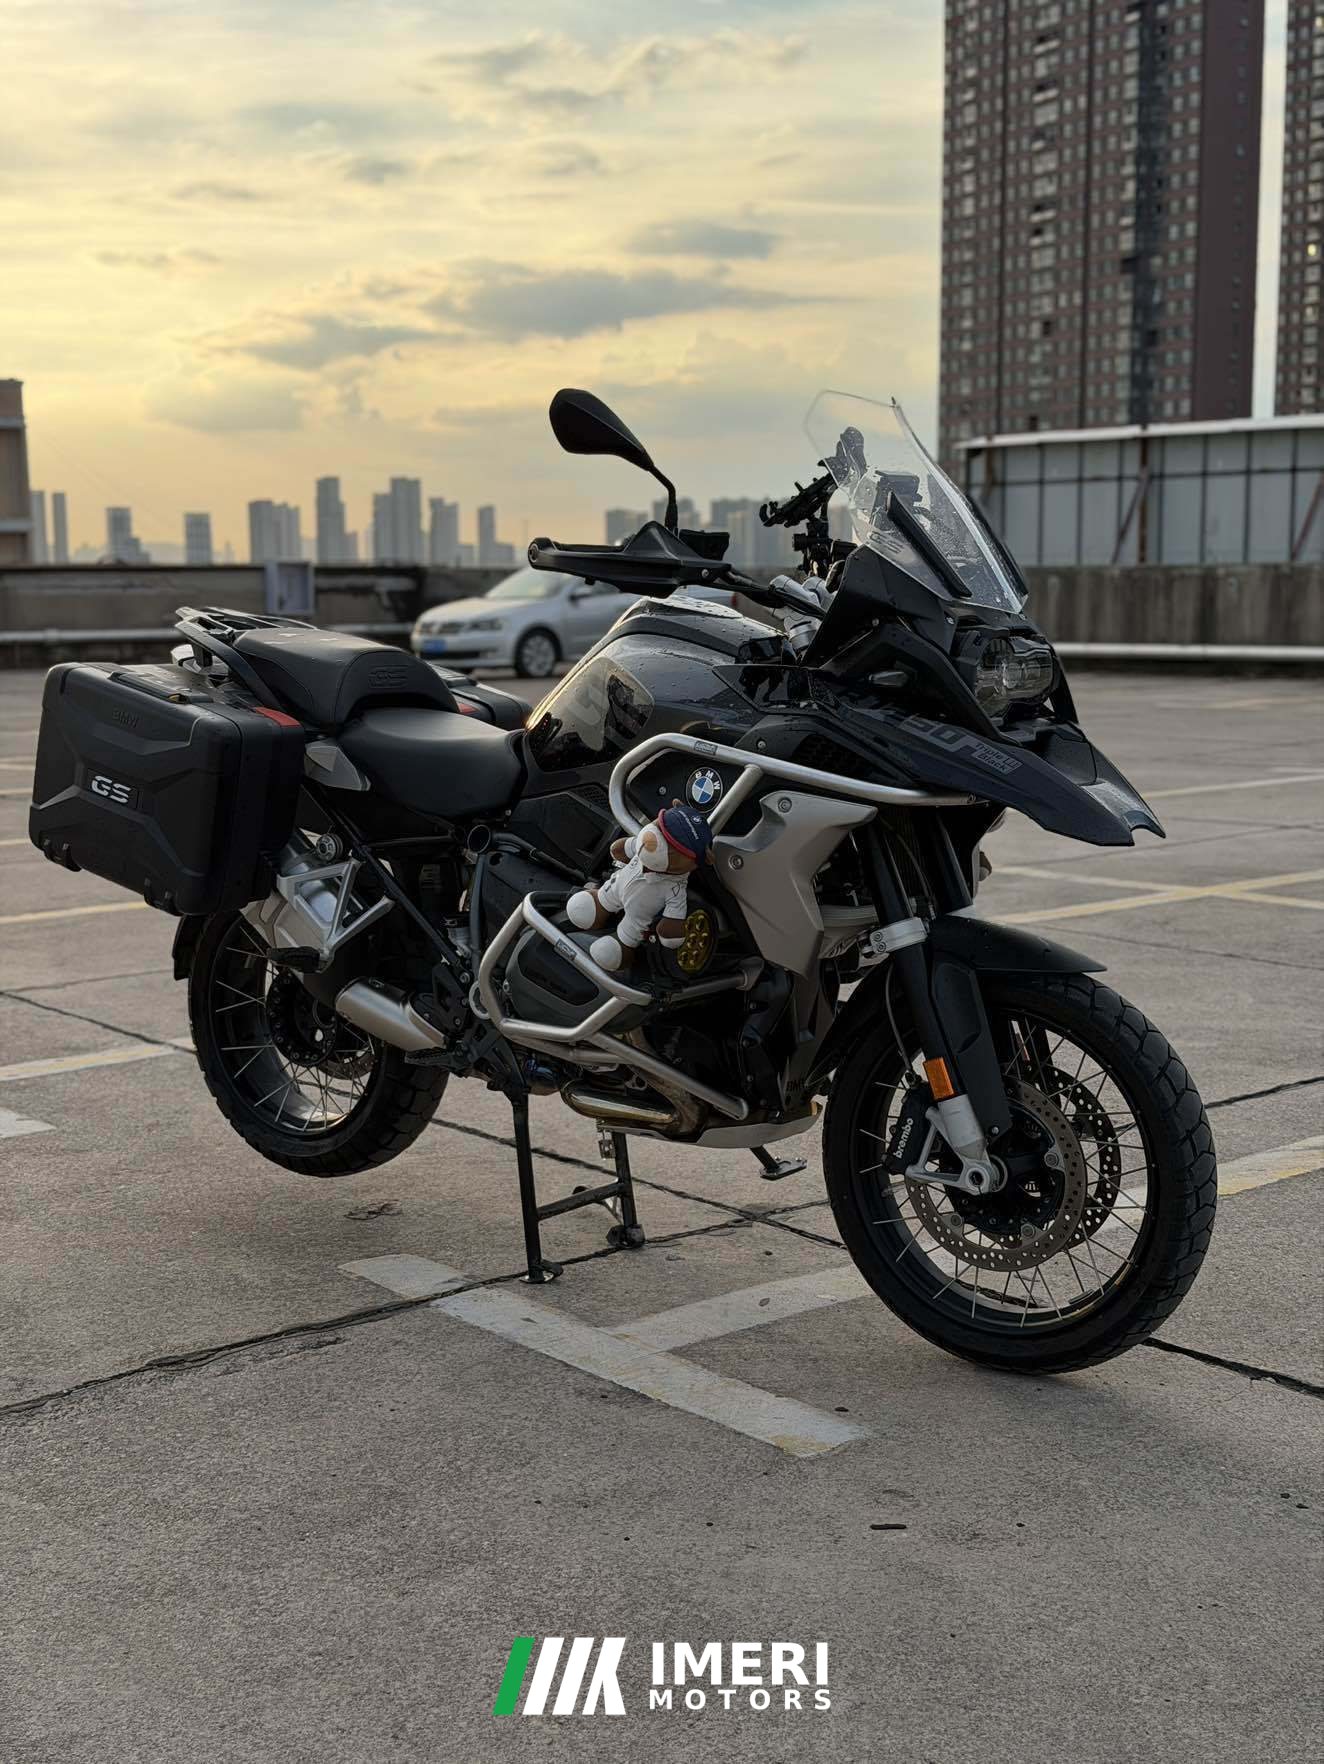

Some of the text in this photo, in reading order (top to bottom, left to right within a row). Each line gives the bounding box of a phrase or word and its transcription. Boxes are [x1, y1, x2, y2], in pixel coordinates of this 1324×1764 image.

[92, 776, 131, 803] GS
[695, 770, 721, 790] BMW
[893, 1118, 913, 1158] brembo
